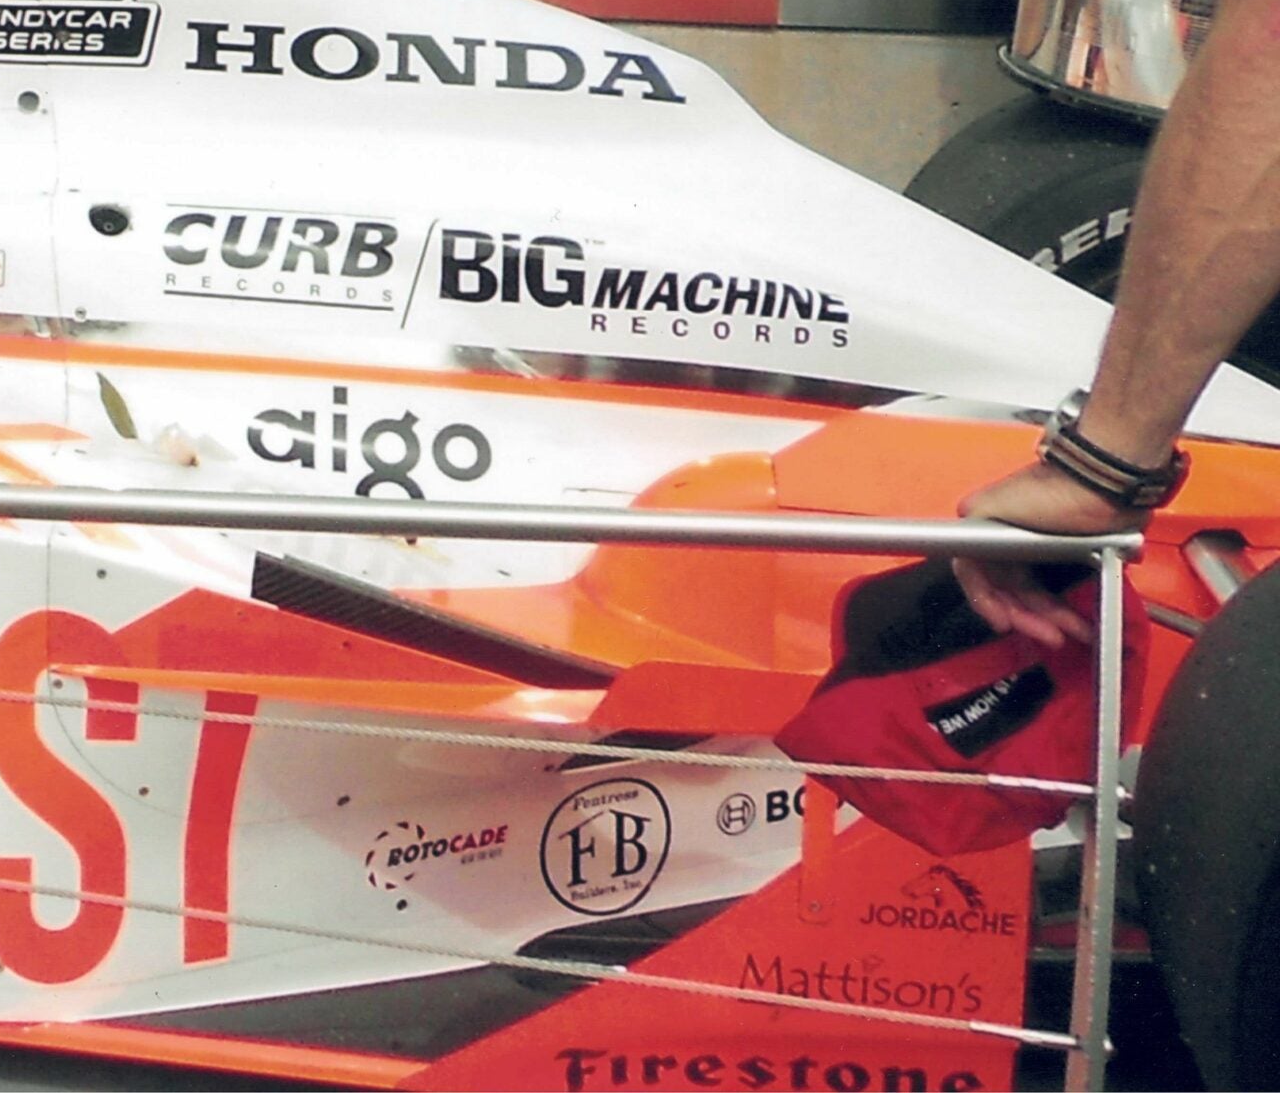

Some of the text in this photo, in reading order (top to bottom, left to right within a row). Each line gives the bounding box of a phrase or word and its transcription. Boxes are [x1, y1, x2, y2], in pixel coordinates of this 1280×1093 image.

[185, 21, 686, 104] HONDA
[163, 212, 398, 278] CURB
[165, 273, 393, 302] RECORDS
[591, 268, 850, 324] MACHINE
[591, 313, 848, 347] RECORDS
[247, 386, 492, 500] aigo
[963, 690, 1000, 723] HOW
[387, 824, 509, 867] ROTOCADE
[860, 904, 1016, 936] JORDACHE
[738, 953, 982, 1014] Mattison's
[554, 1047, 985, 1093] Firestone
